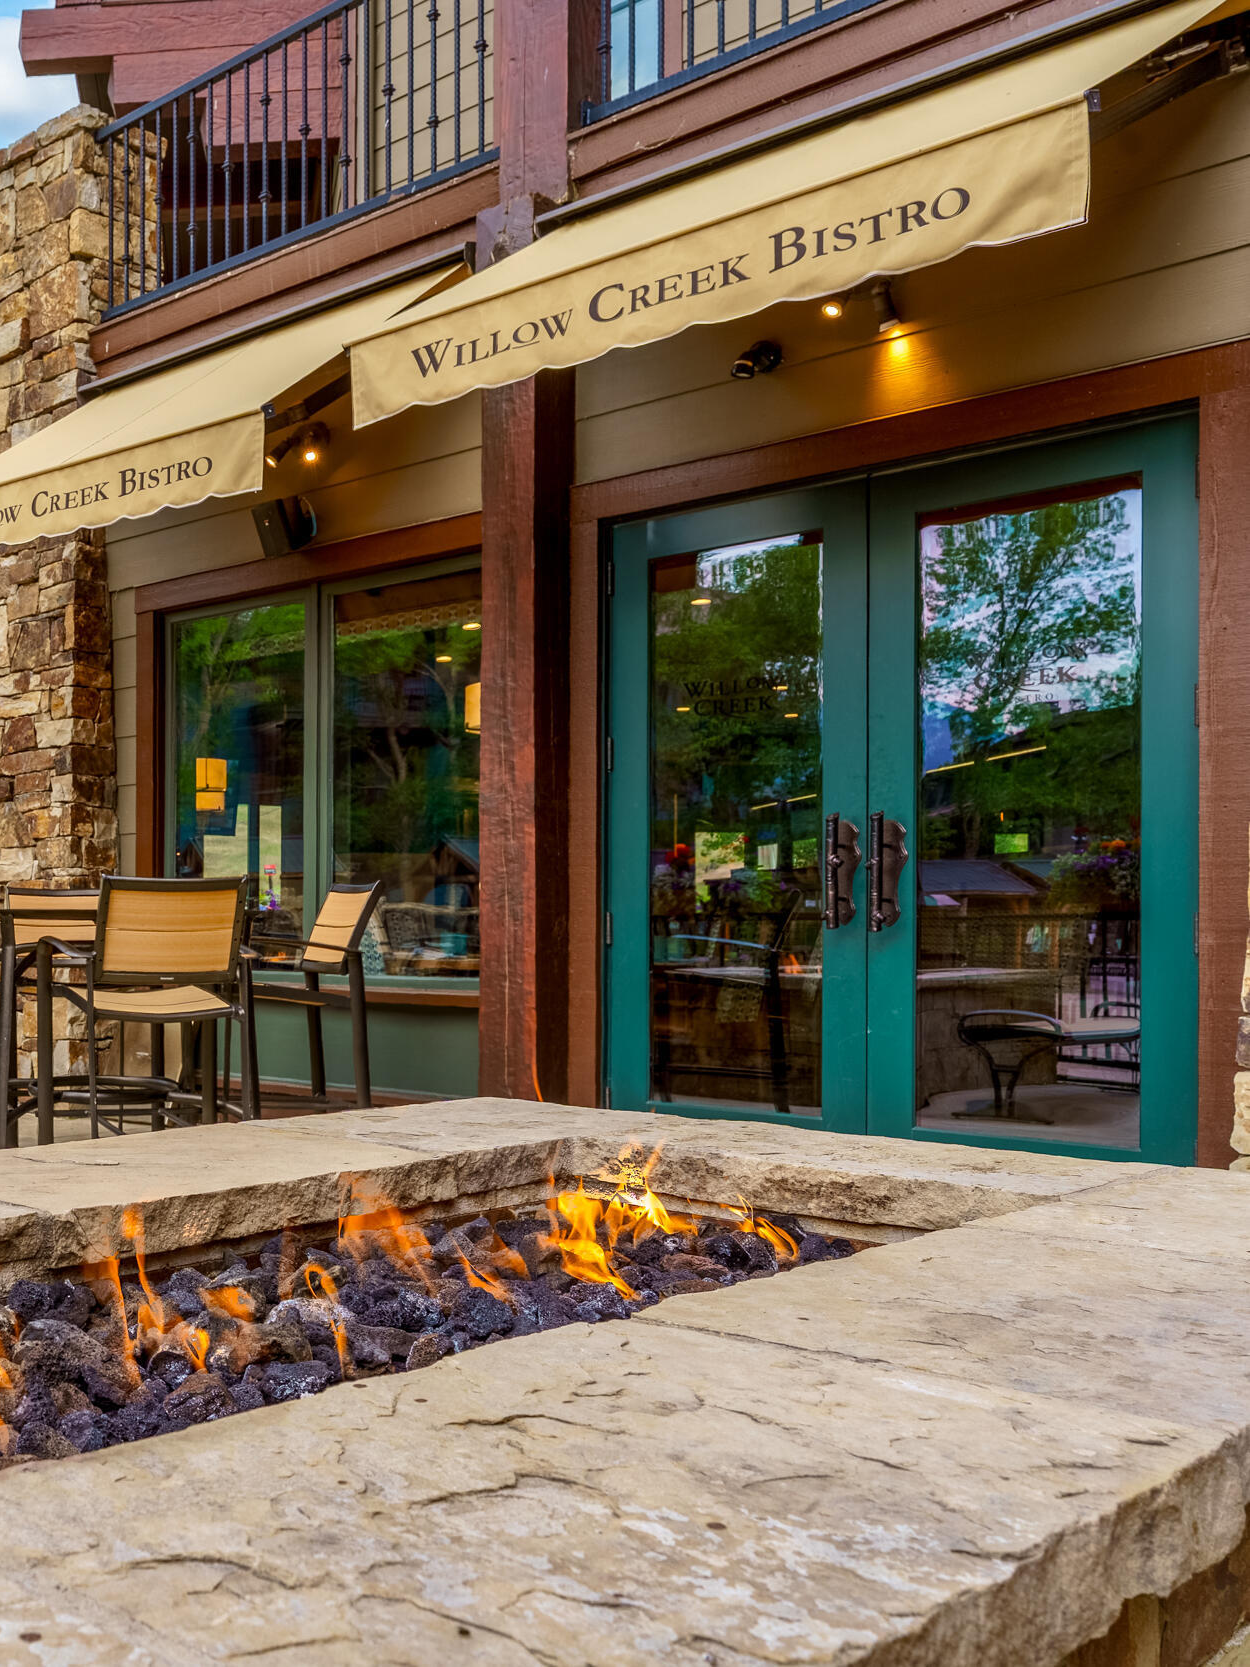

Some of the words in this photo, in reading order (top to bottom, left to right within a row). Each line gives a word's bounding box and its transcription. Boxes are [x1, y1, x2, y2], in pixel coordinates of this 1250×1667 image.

[410, 308, 574, 379] WILLOW
[588, 252, 752, 324] CREEK
[768, 186, 971, 274] BISTRO
[31, 481, 110, 518] CREEK
[117, 456, 213, 498] BISTRO
[684, 675, 785, 698] WILLOW
[694, 696, 773, 719] CREEK
